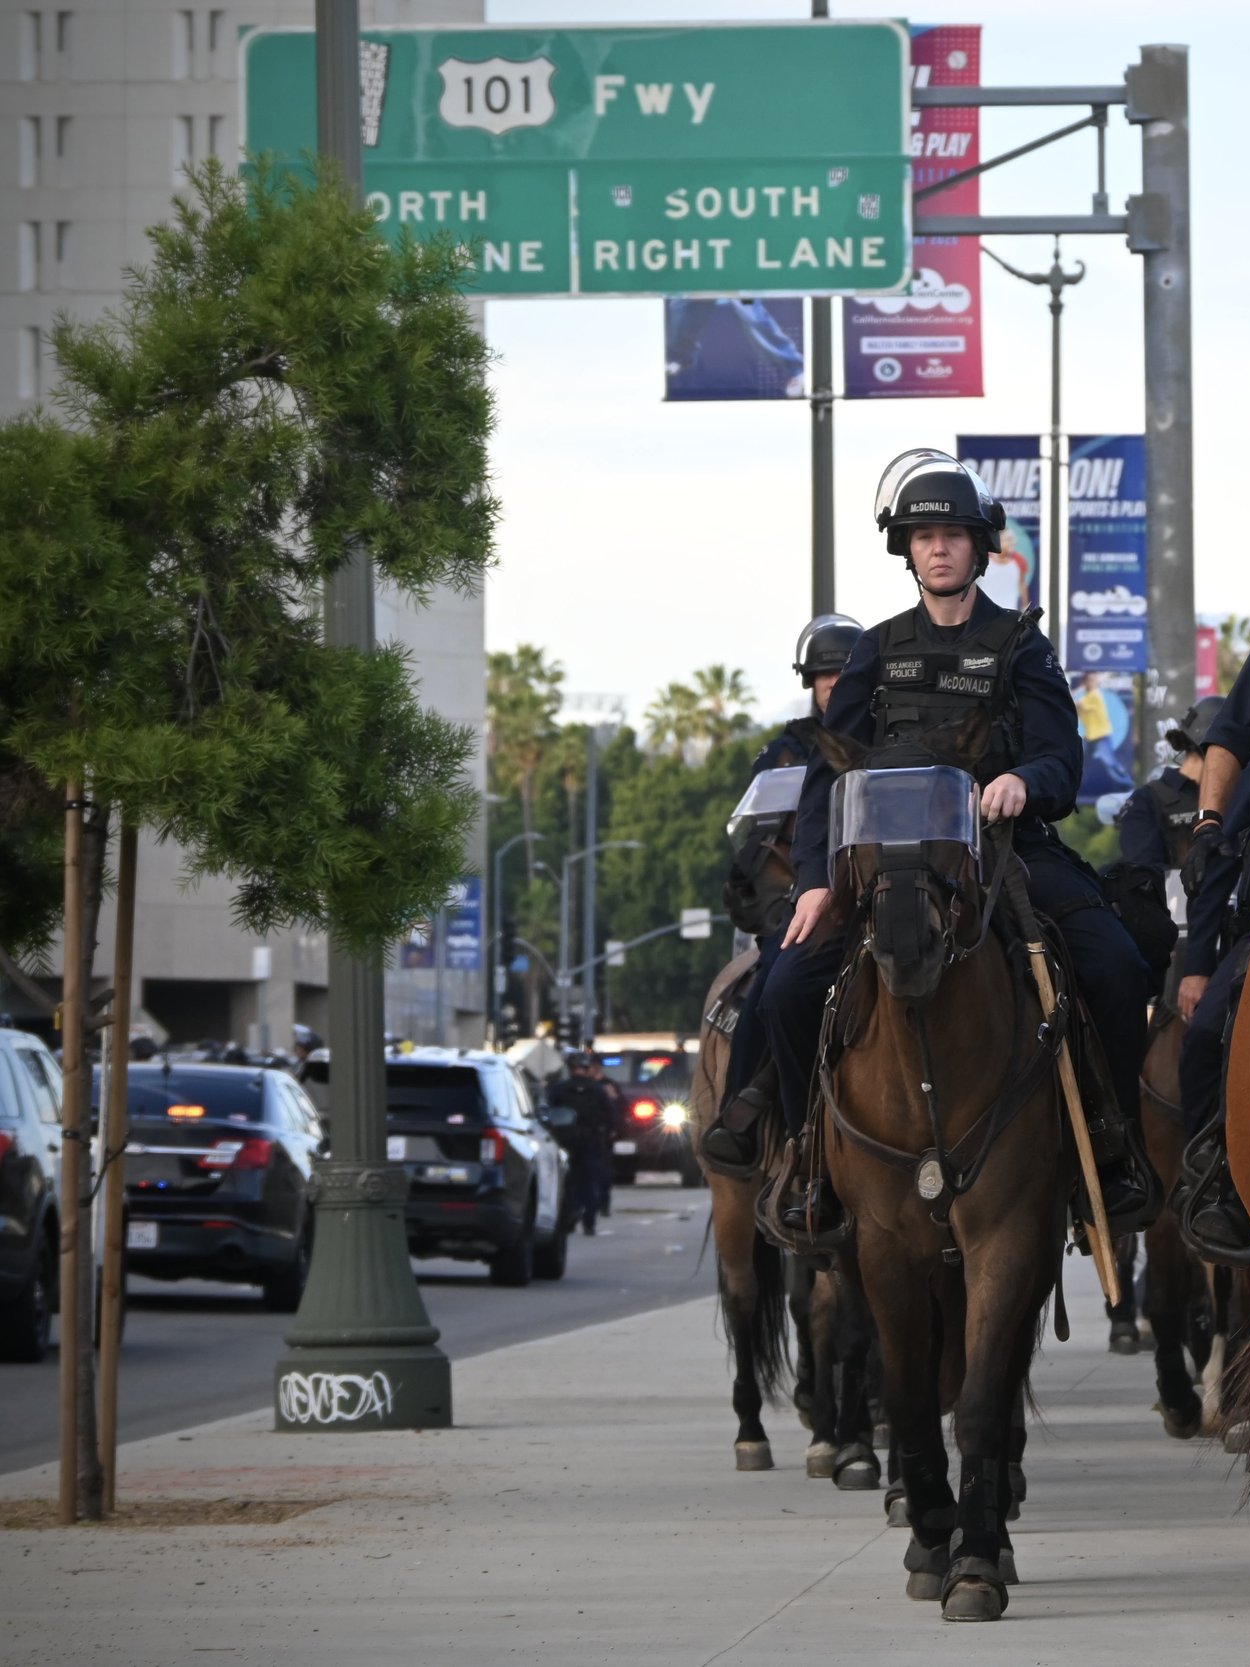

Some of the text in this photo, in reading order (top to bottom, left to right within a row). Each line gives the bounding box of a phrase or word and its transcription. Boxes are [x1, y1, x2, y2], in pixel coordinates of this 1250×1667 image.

[464, 75, 531, 114] 101
[595, 74, 715, 124] Fwy
[925, 132, 972, 157] PLAY
[364, 190, 487, 222] ORTH
[665, 186, 820, 219] SOUTH
[594, 237, 887, 271] RIGHT LANE
[1069, 458, 1124, 499] ON!
[910, 501, 950, 513] McDONALD
[890, 669, 918, 678] POLICE
[898, 661, 922, 669] ANGELES
[939, 675, 991, 693] McDONALD
